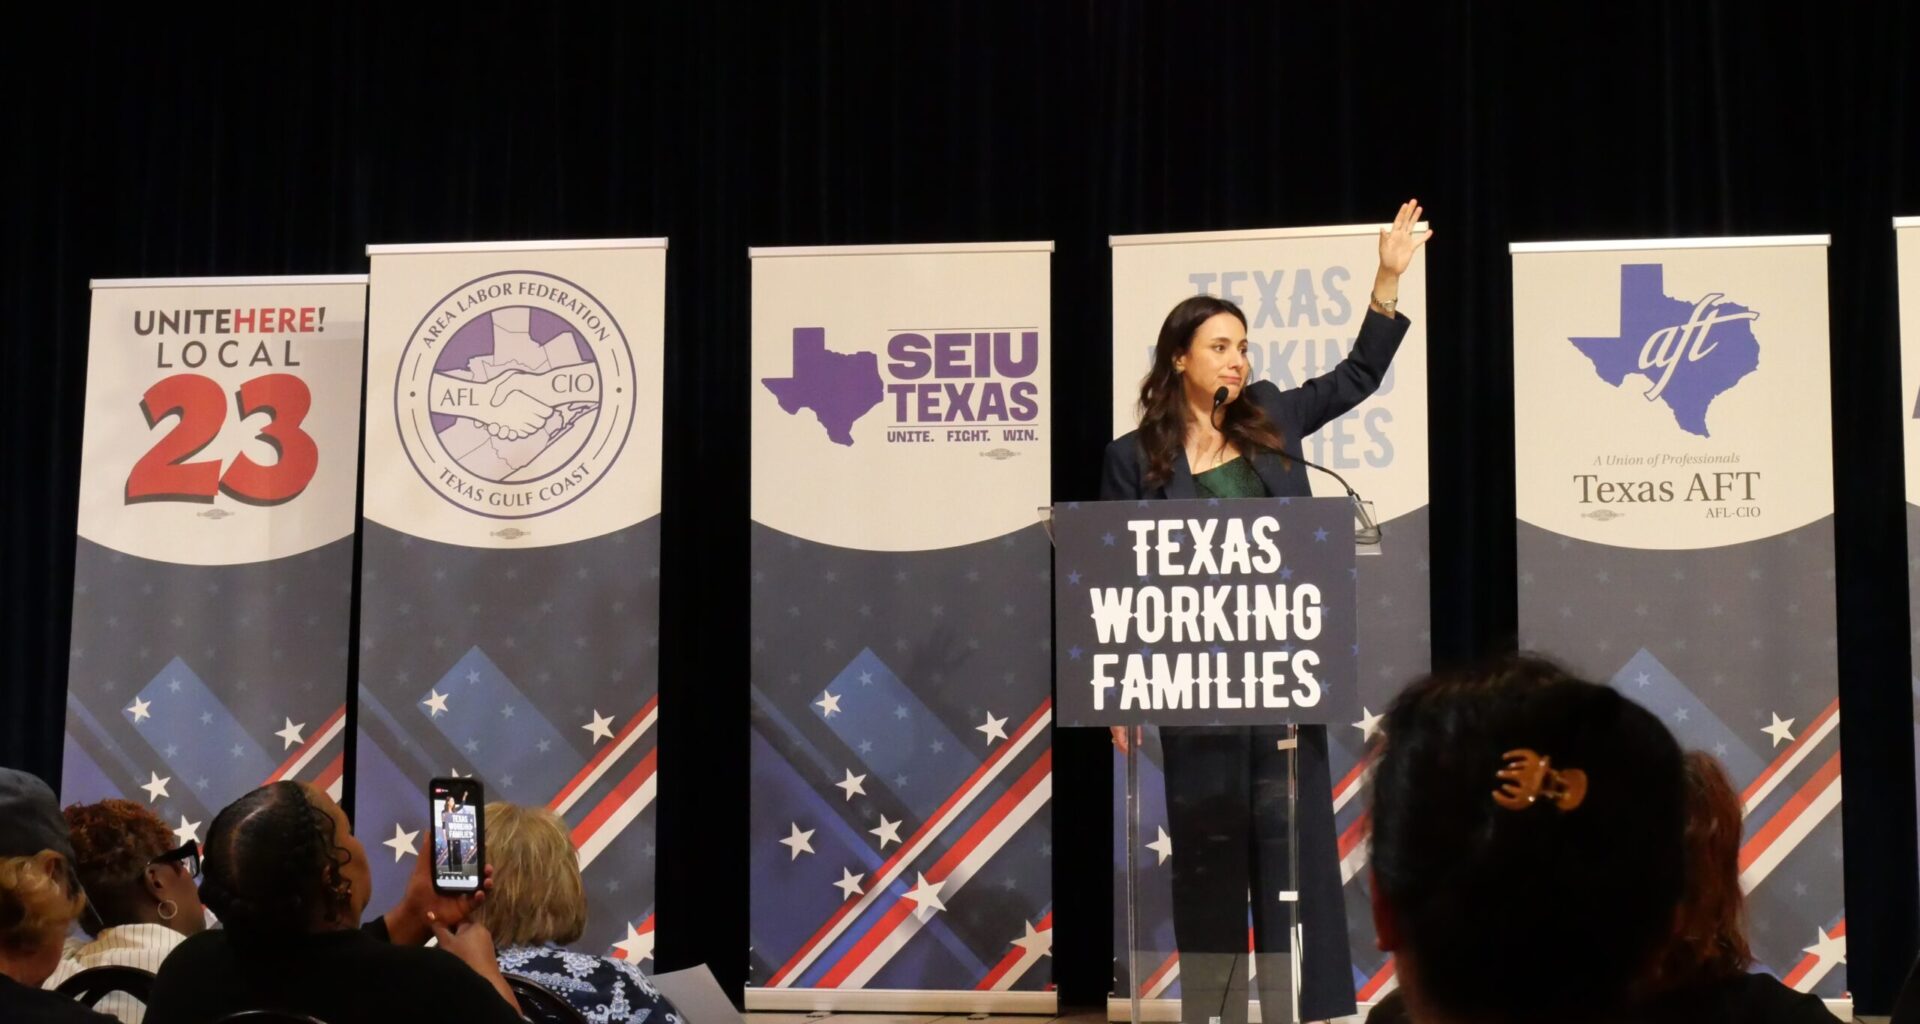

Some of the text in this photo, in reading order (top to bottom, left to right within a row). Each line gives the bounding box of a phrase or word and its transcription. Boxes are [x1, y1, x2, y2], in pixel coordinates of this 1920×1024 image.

[134, 307, 326, 336] UNITEHERE!
[422, 282, 610, 349] AREA LABOR FEDERATION
[157, 340, 300, 368] LOCAL
[887, 332, 1039, 380] SEIU
[1638, 292, 1760, 402] aft
[440, 388, 479, 407] AFL
[551, 373, 594, 393] CIO
[887, 381, 1039, 422] TEXAS
[124, 373, 319, 507] 23
[887, 429, 1039, 443] UNITE. FIGHT. WIN.
[1593, 452, 1741, 468] A Union of Professionals
[439, 463, 591, 507] TEXAS GULF COAST
[1573, 471, 1761, 503] Texas AFT
[1705, 506, 1761, 519] AFL-CIO
[1127, 516, 1281, 576] TEXAS
[1089, 583, 1321, 644] WORKING
[1090, 649, 1321, 710] FAMILIES
